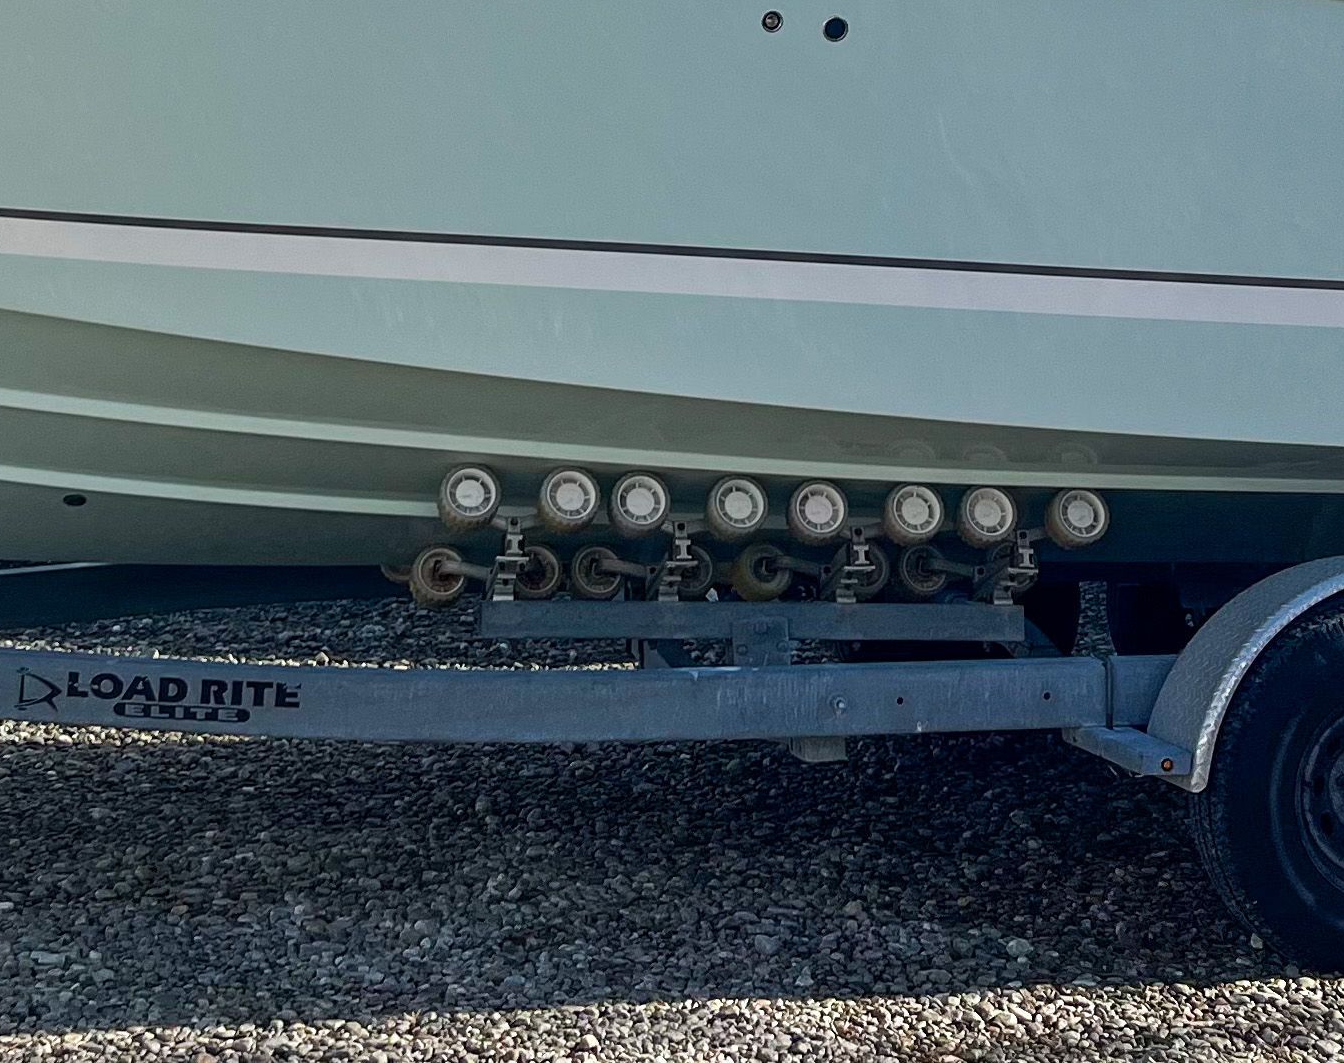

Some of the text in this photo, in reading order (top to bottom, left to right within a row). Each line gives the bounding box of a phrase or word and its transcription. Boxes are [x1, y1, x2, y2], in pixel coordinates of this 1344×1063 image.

[66, 671, 302, 708] LOAD RITE
[124, 703, 240, 722] ELITE
